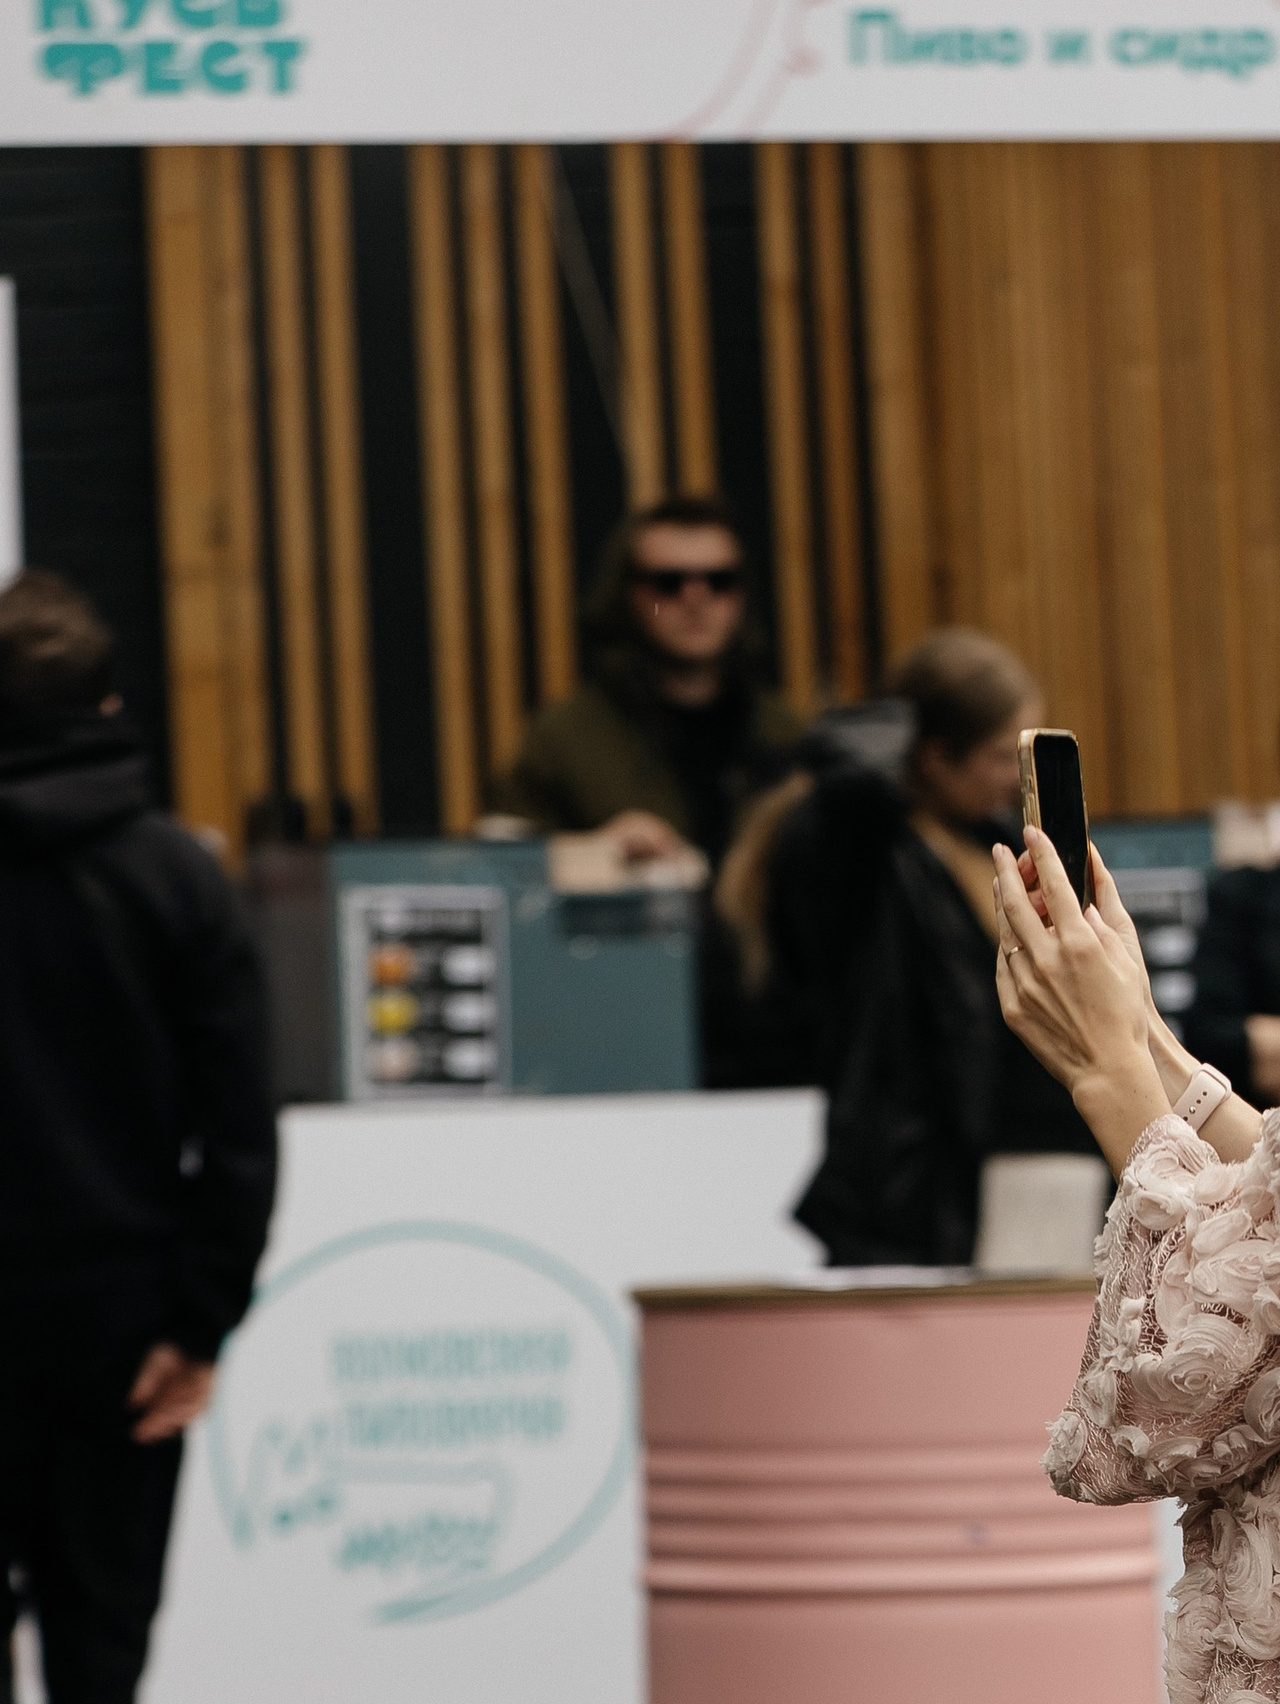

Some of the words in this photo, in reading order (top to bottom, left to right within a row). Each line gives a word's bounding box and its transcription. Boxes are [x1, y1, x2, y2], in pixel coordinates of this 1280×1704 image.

[42, 38, 304, 97] ФЕСТ
[848, 8, 1027, 67] Пиво
[1046, 27, 1092, 67] и
[1107, 26, 1277, 80] сидр
